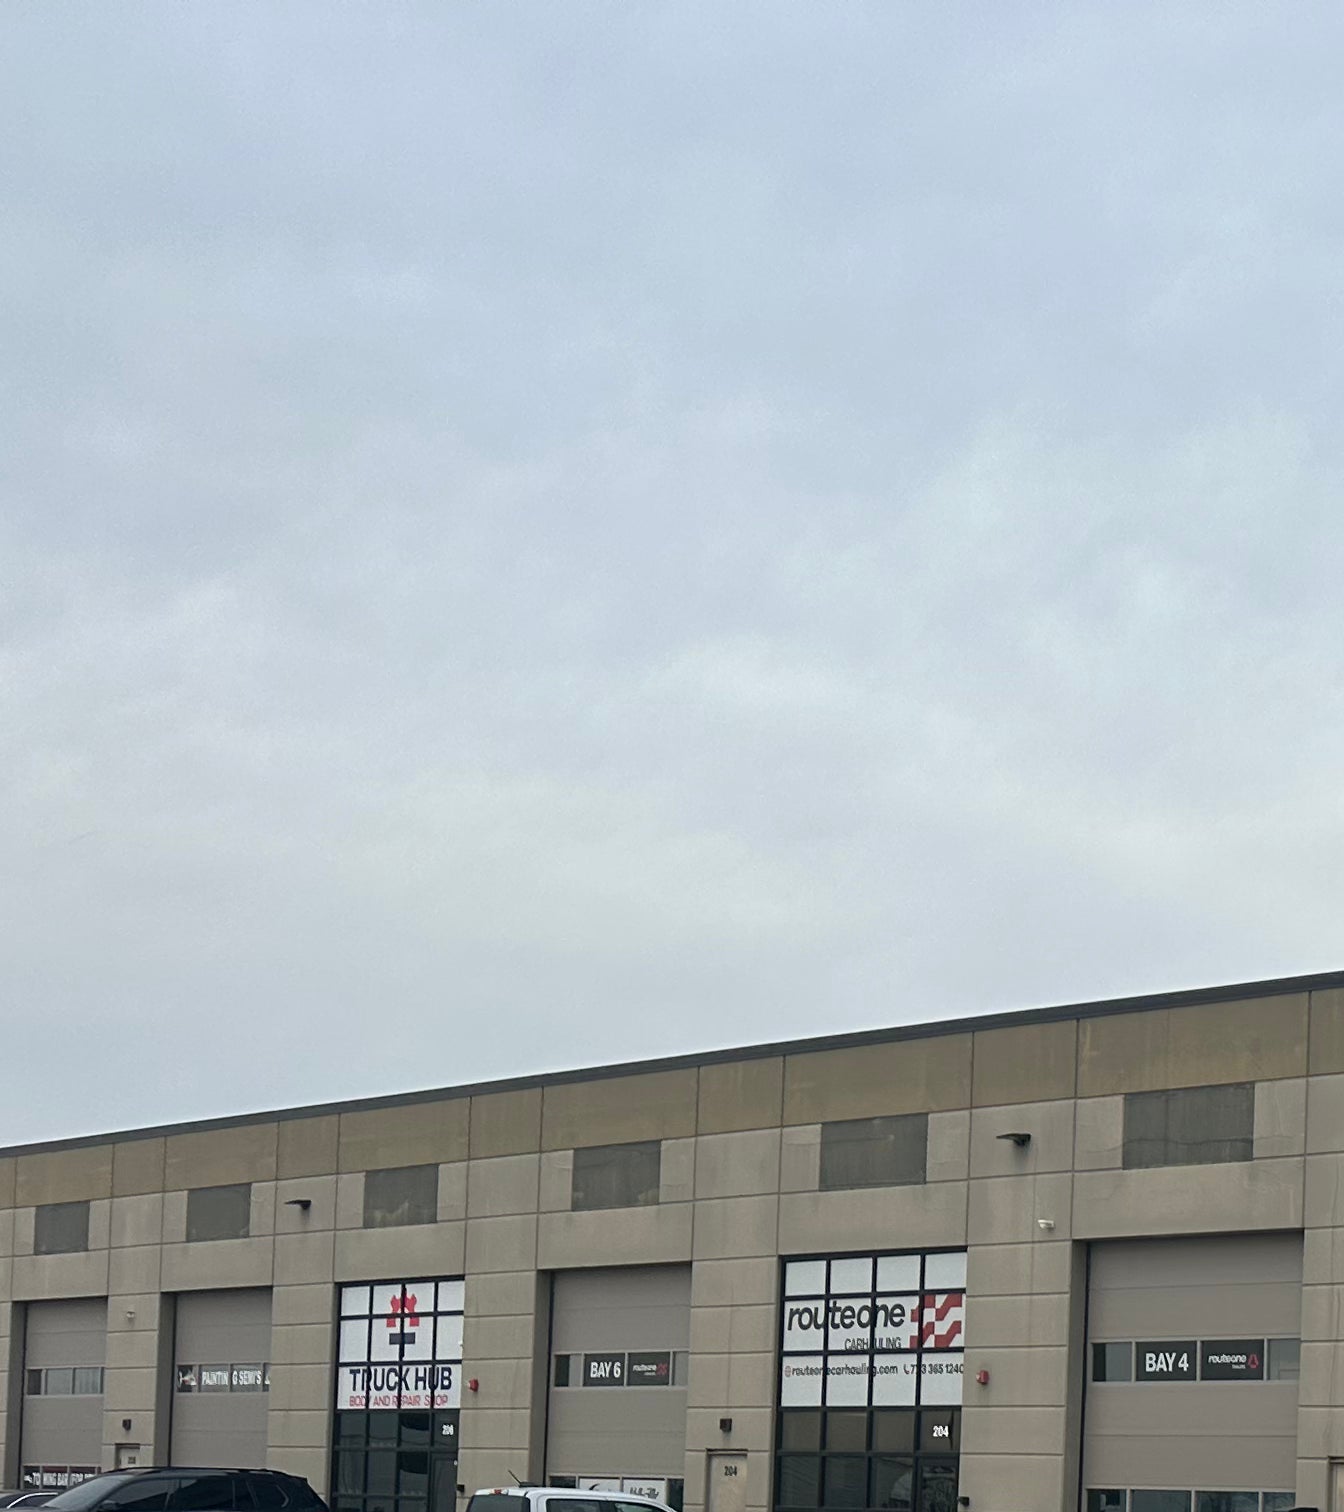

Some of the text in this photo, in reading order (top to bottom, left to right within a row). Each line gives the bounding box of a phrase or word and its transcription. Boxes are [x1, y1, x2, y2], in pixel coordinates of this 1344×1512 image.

[787, 1300, 906, 1331] routeone
[844, 1336, 902, 1350] CARHULING
[911, 1363, 927, 1375] 73
[1145, 1352, 1189, 1372] BAY 4
[590, 1361, 621, 1378] BAY 6
[349, 1366, 453, 1392] TRUCK HUB
[349, 1394, 448, 1407] BOD AND RPAIR SOP
[932, 1425, 949, 1438] 204
[724, 1465, 738, 1477] 204
